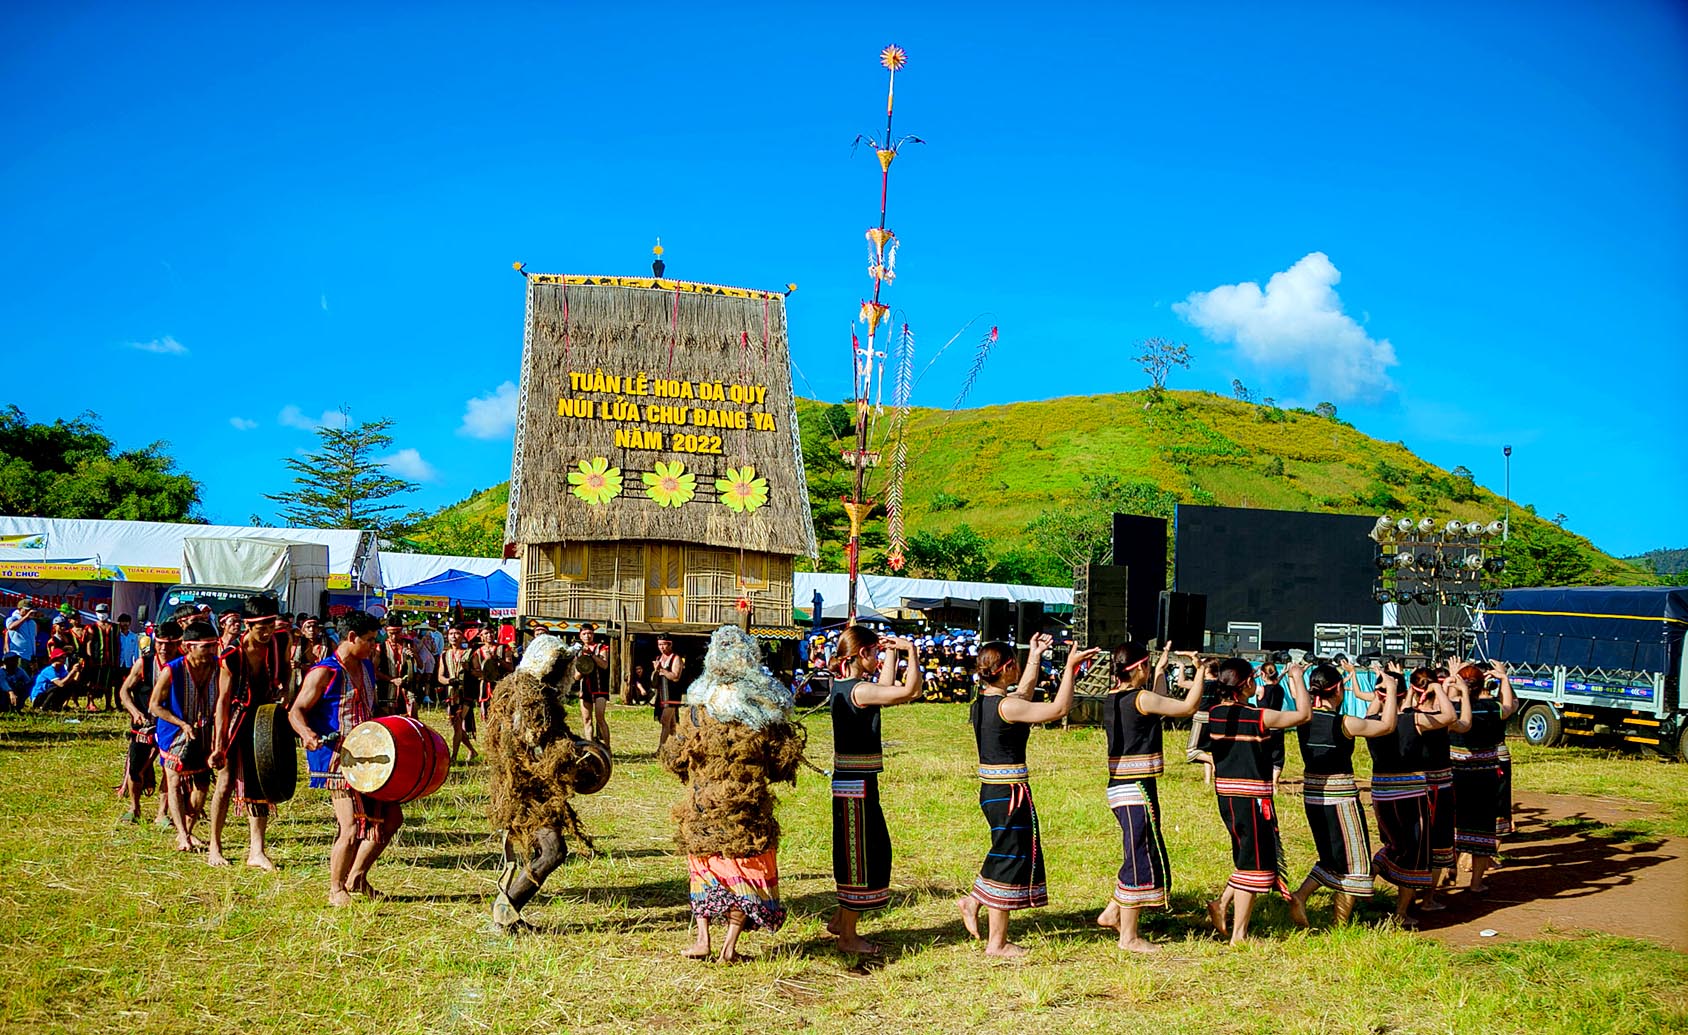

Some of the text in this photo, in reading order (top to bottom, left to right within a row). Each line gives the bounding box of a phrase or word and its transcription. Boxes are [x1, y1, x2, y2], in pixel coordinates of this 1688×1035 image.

[569, 368, 621, 394] TUẦN
[625, 372, 648, 396] LỄ
[654, 379, 693, 400] HOA
[701, 380, 726, 402] DÃ
[558, 396, 776, 432] NÚI LỬA CHƯ ĐANG YA
[615, 427, 723, 454] NĂM 2022
